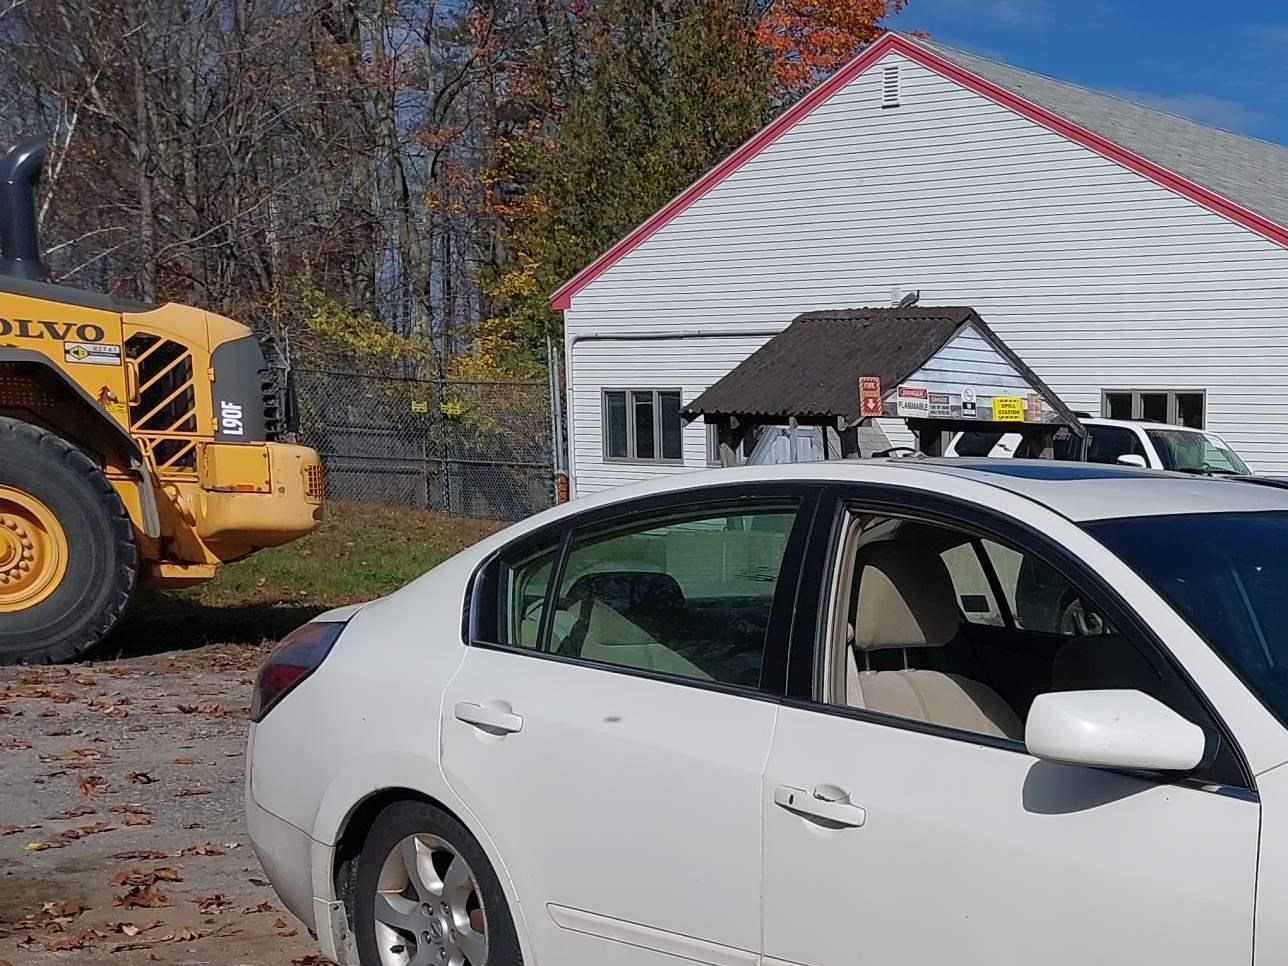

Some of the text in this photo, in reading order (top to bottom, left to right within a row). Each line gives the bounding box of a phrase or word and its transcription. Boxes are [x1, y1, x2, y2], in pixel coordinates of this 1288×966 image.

[902, 389, 924, 397] DANGER
[899, 401, 929, 411] FLAMMABLE
[221, 400, 244, 436] L90F
